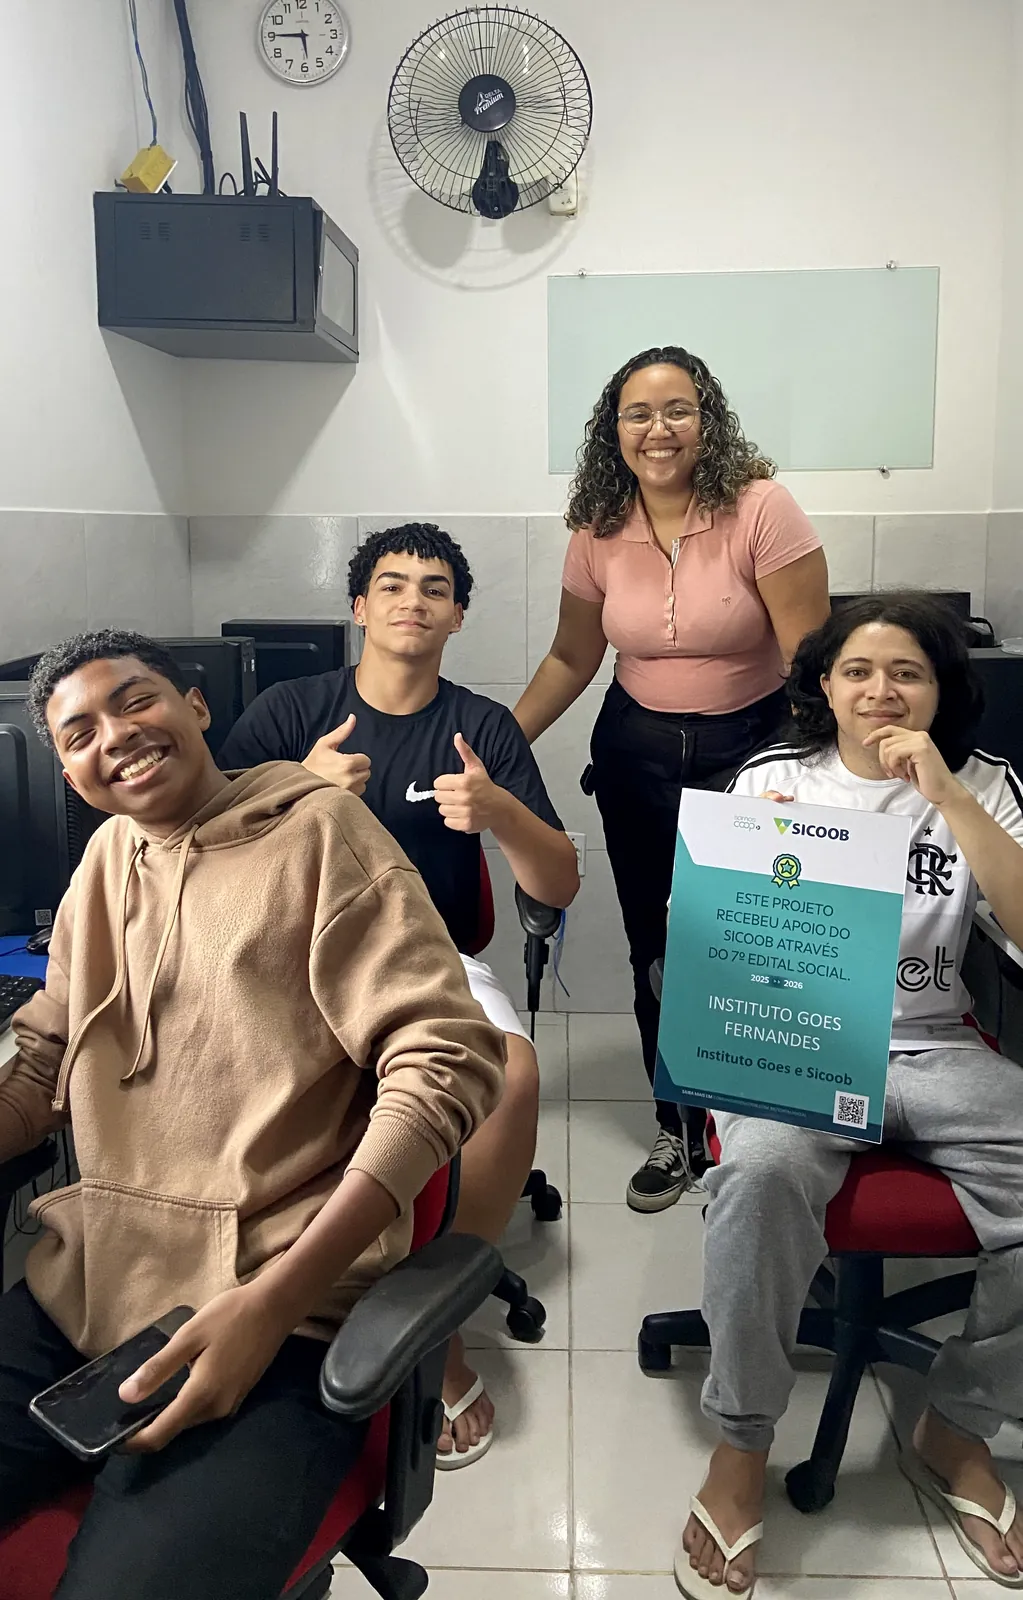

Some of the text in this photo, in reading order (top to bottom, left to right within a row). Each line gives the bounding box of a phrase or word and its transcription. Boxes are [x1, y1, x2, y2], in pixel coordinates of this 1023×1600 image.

[283, 4, 291, 13] 11
[295, 0, 307, 9] 12
[315, 2, 320, 12] 1
[271, 15, 283, 25] 10
[325, 14, 332, 24] 2
[268, 31, 275, 42] 9
[330, 29, 338, 39] 3
[274, 48, 282, 58] 8
[325, 45, 333, 55] 4
[285, 59, 293, 69] 7
[301, 62, 309, 73] 6
[316, 58, 323, 68] 5
[484, 88, 502, 99] DELTA
[474, 93, 504, 115] Premium
[791, 823, 850, 841] SICOOB
[736, 892, 834, 917] ESTE PROJETO
[716, 909, 851, 940] RECEBEU APOIO DO
[724, 930, 839, 958] SICOOB ATRAVÉS
[708, 947, 729, 961] DO
[748, 954, 795, 972] EDITAL
[797, 961, 851, 981] SOCIAL.
[751, 974, 803, 990] 2025 2026
[708, 995, 842, 1031] INSTITUTO GOES
[724, 1021, 821, 1051] FERNANDES
[696, 1046, 853, 1086] Instituto Goes e Sicoob
